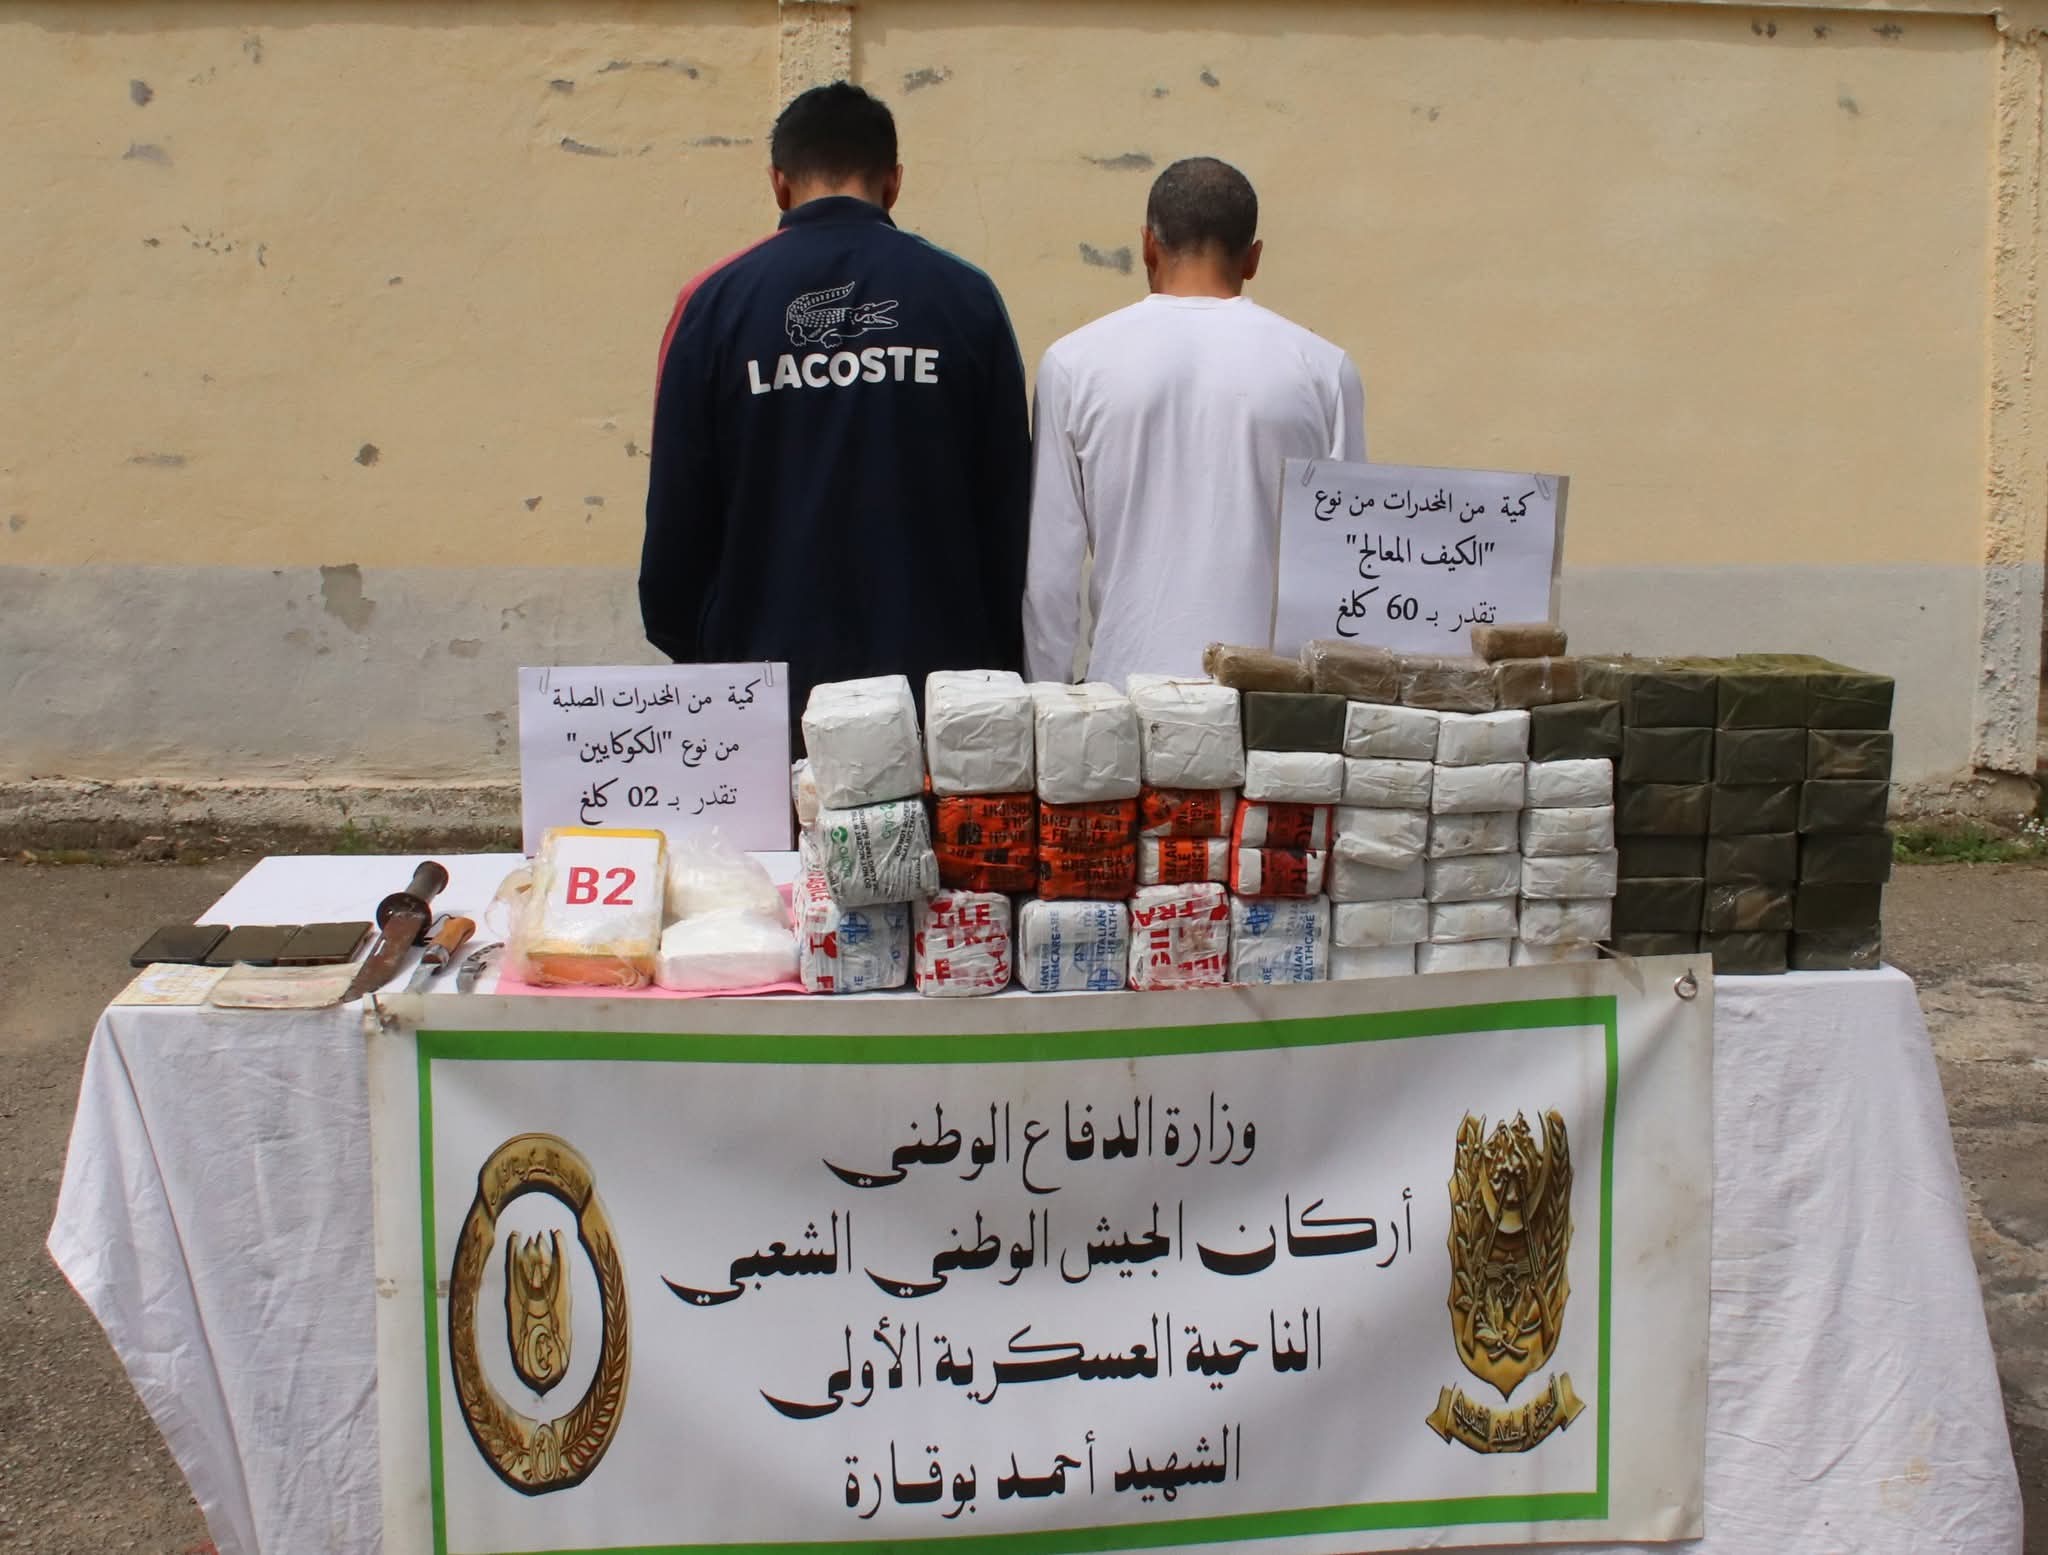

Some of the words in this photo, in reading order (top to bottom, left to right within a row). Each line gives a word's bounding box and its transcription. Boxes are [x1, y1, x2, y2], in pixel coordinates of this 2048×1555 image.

[748, 347, 939, 394] LACOSTE
[1314, 489, 1342, 521] نوع
[1349, 495, 1375, 517] من
[1384, 489, 1452, 519] المخدرات
[1459, 501, 1485, 523] من
[1500, 490, 1535, 523] كمية
[1346, 533, 1411, 580] المعالج"
[1421, 535, 1495, 572] "الكيف
[1336, 586, 1379, 637] كلغ
[1387, 594, 1419, 621] 60
[1449, 601, 1496, 633] تقدر
[553, 686, 605, 712] الصلبة
[612, 684, 679, 714] المخدرات
[687, 693, 712, 713] من
[728, 678, 761, 712] كمية
[682, 738, 707, 767] نوع
[715, 741, 739, 760] من
[580, 778, 619, 825] كلغ
[628, 786, 659, 807] 02
[692, 784, 738, 814] تقدر
[567, 867, 636, 905] B2
[1097, 909, 1107, 955] ITALIAN
[822, 1101, 1010, 1188] الوطني
[1022, 1094, 1152, 1194] الدفاع
[1165, 1091, 1256, 1167] وزارة
[1060, 1200, 1183, 1283] الجيش
[1197, 1187, 1413, 1276] أركان
[661, 1209, 851, 1306] الشعبي
[864, 1208, 1048, 1298] الوطني
[760, 1316, 921, 1420] الأولى
[935, 1311, 1172, 1404] العسكرية
[1184, 1306, 1322, 1390] الناحية
[997, 1430, 1096, 1499] أحمد
[1114, 1423, 1241, 1501] الشهيد
